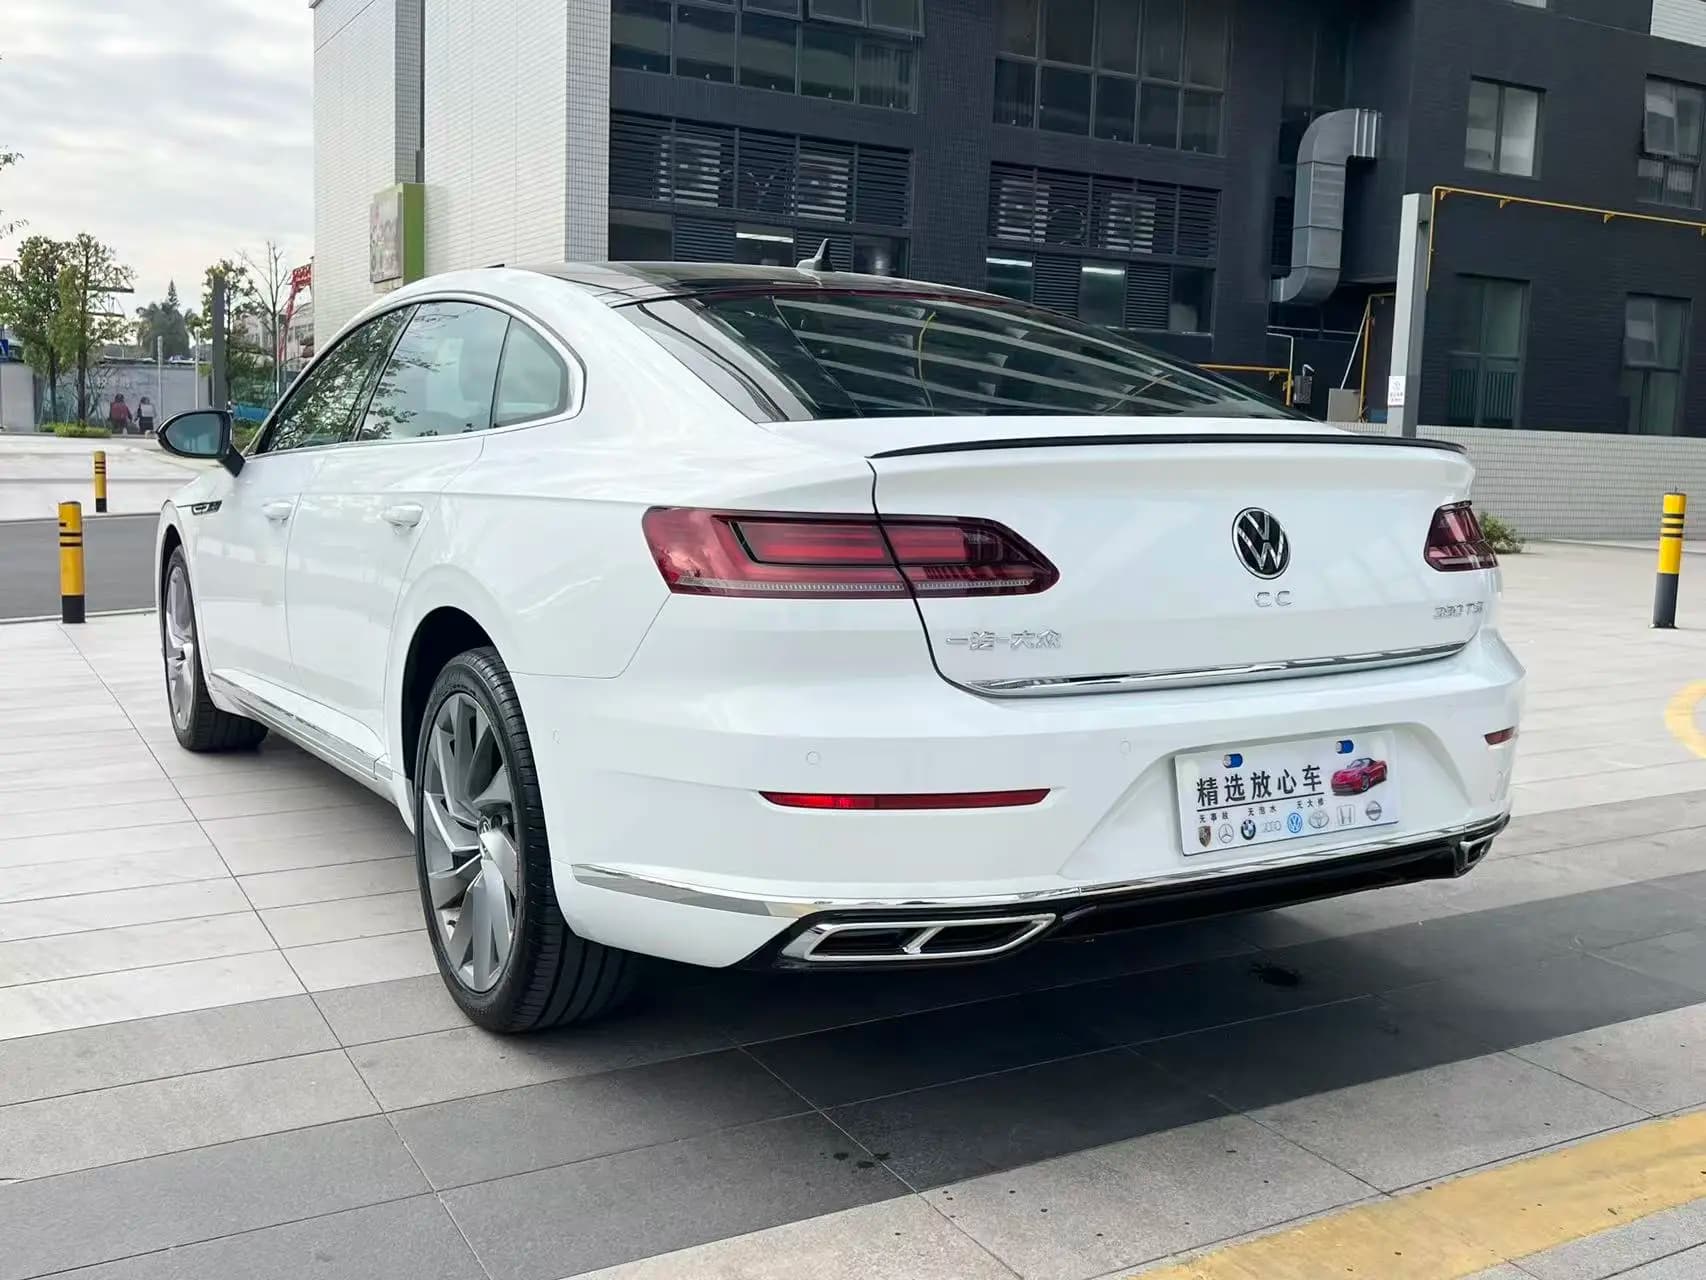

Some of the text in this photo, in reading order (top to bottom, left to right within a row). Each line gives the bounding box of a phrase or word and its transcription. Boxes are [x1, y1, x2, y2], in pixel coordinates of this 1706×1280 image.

[1254, 590, 1292, 607] CC
[1196, 764, 1322, 807] 精选放心车
